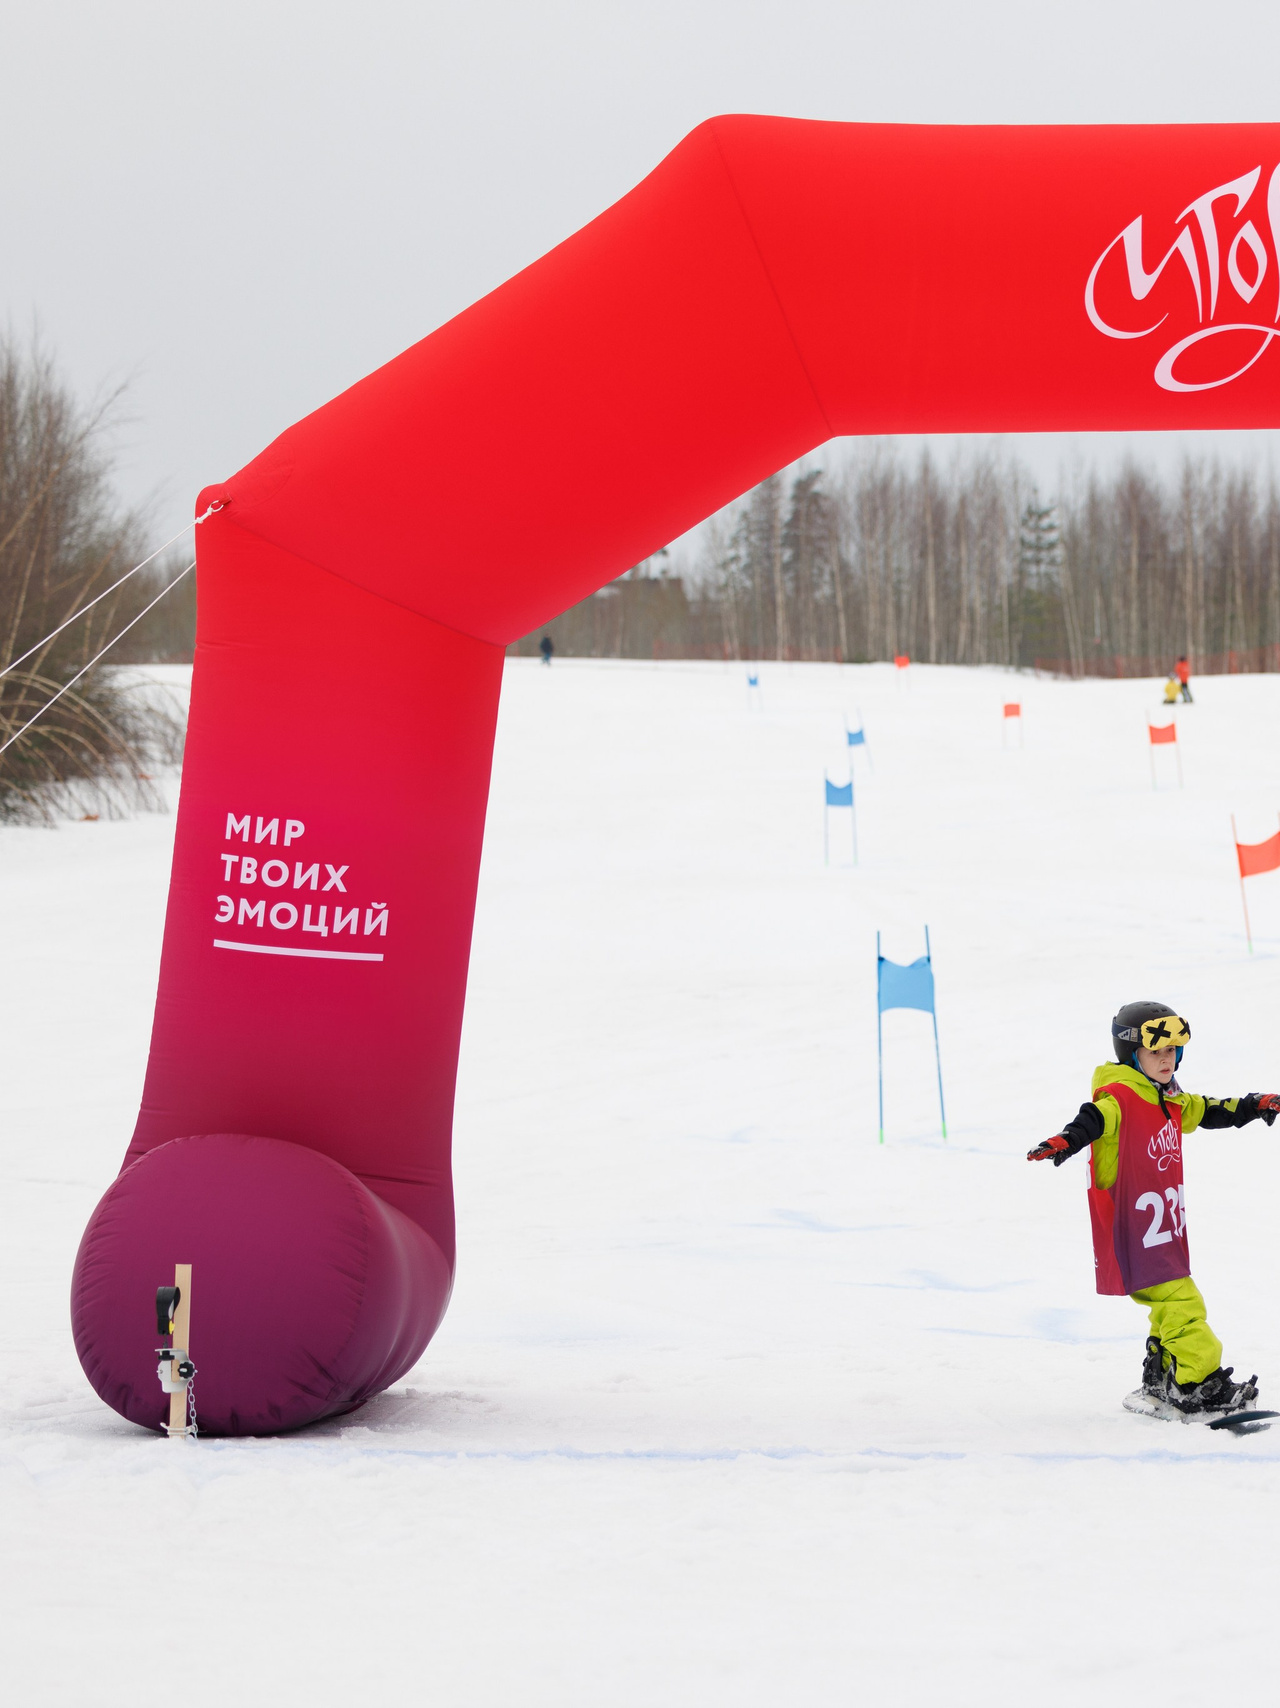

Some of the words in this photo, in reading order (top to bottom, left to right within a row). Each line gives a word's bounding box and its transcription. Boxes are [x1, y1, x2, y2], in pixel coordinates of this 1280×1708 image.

[225, 812, 305, 847] МИР
[220, 853, 350, 893] ТВОИХ
[214, 894, 389, 937] ЭМОЦИЙ
